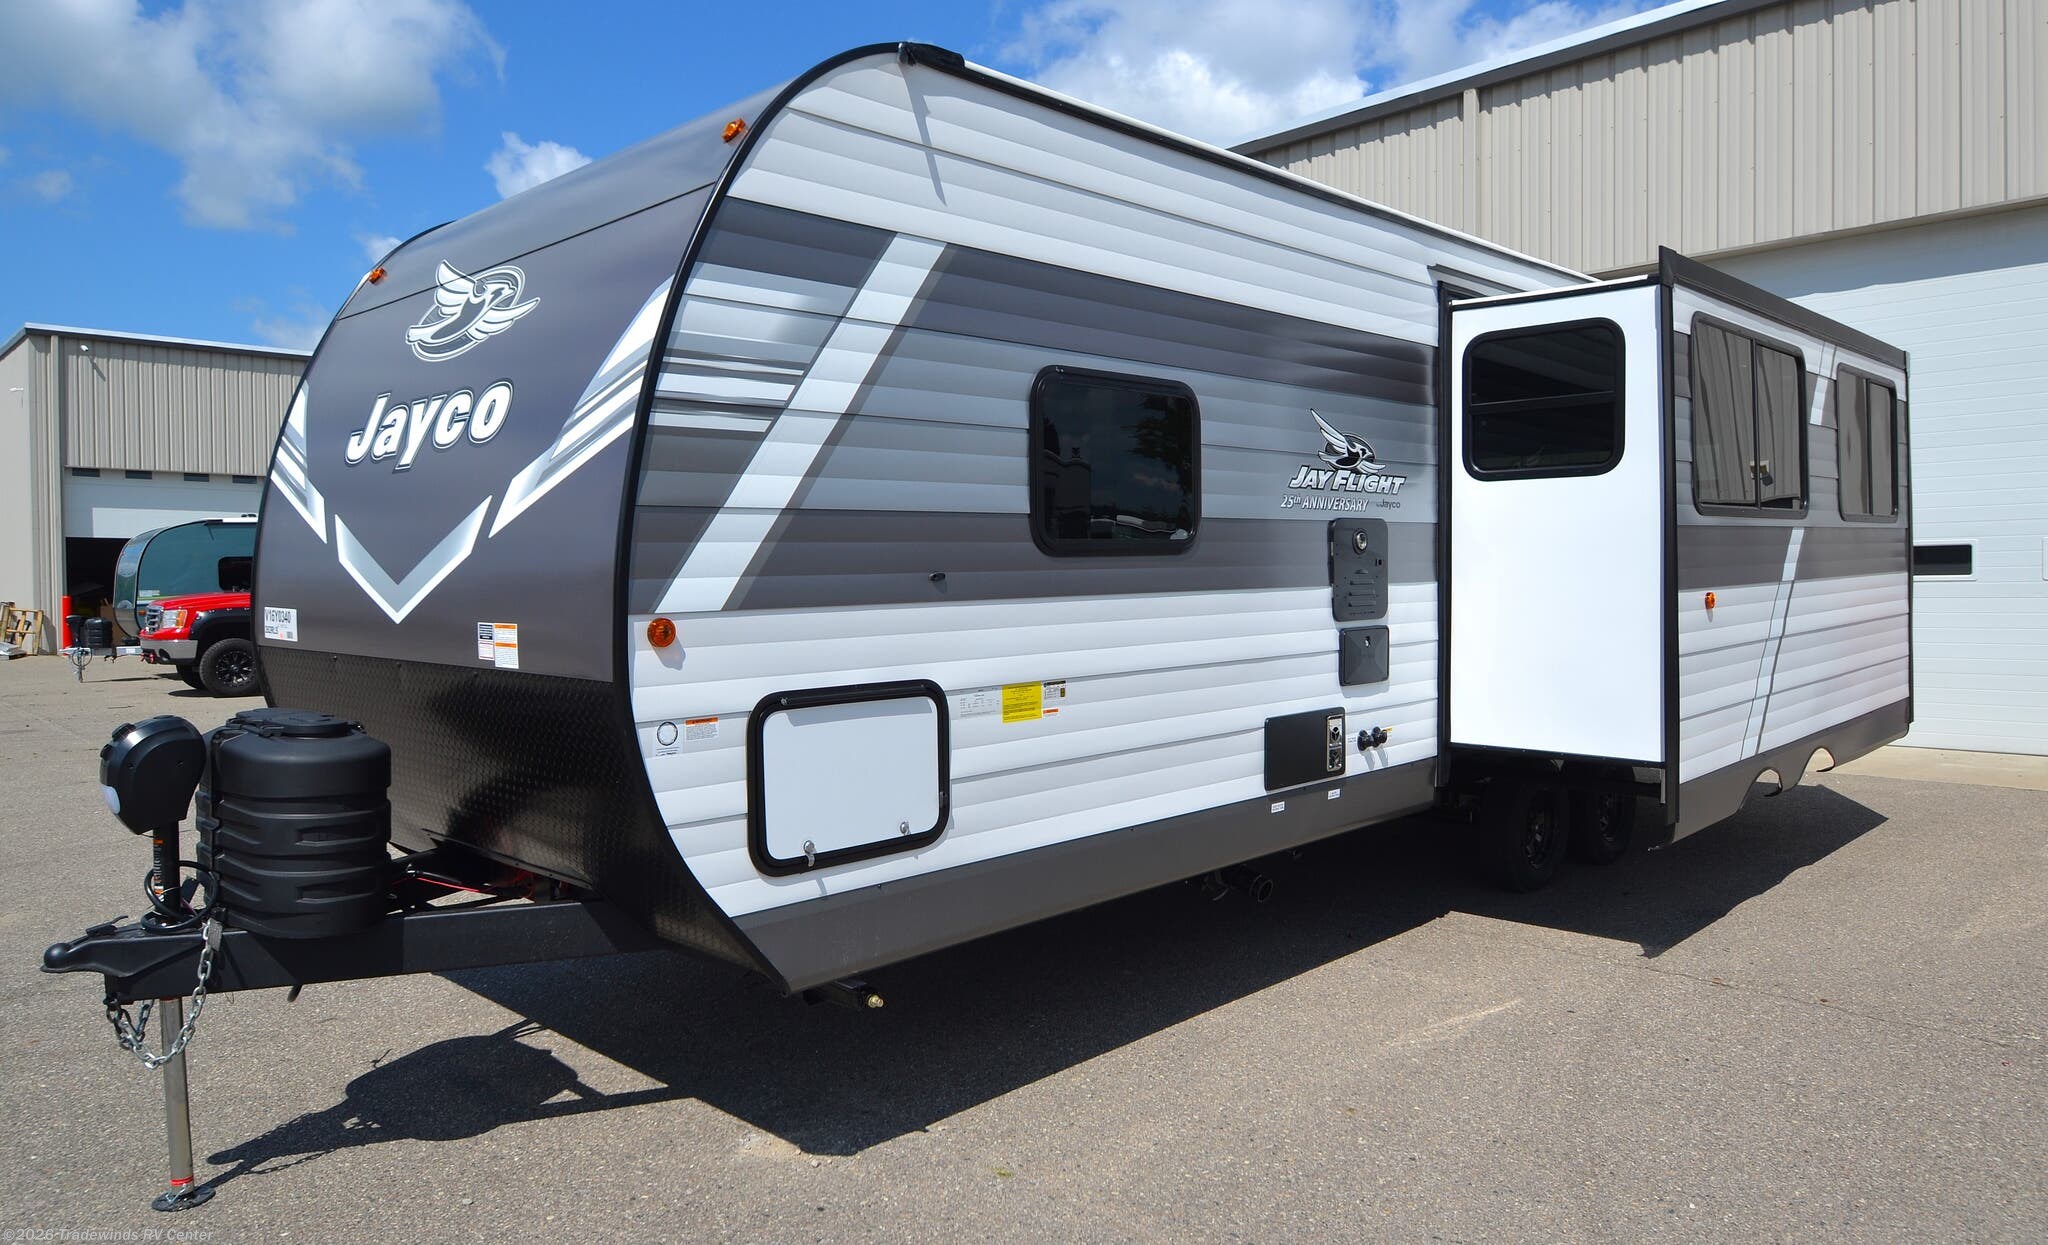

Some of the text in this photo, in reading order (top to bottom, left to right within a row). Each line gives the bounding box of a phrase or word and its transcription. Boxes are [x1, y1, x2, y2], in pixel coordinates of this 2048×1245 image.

[344, 379, 514, 471] Jayco
[1288, 465, 1406, 495] JAY FLIGHT
[1280, 494, 1301, 509] 25th
[1302, 495, 1369, 512] ANNIVERSARY
